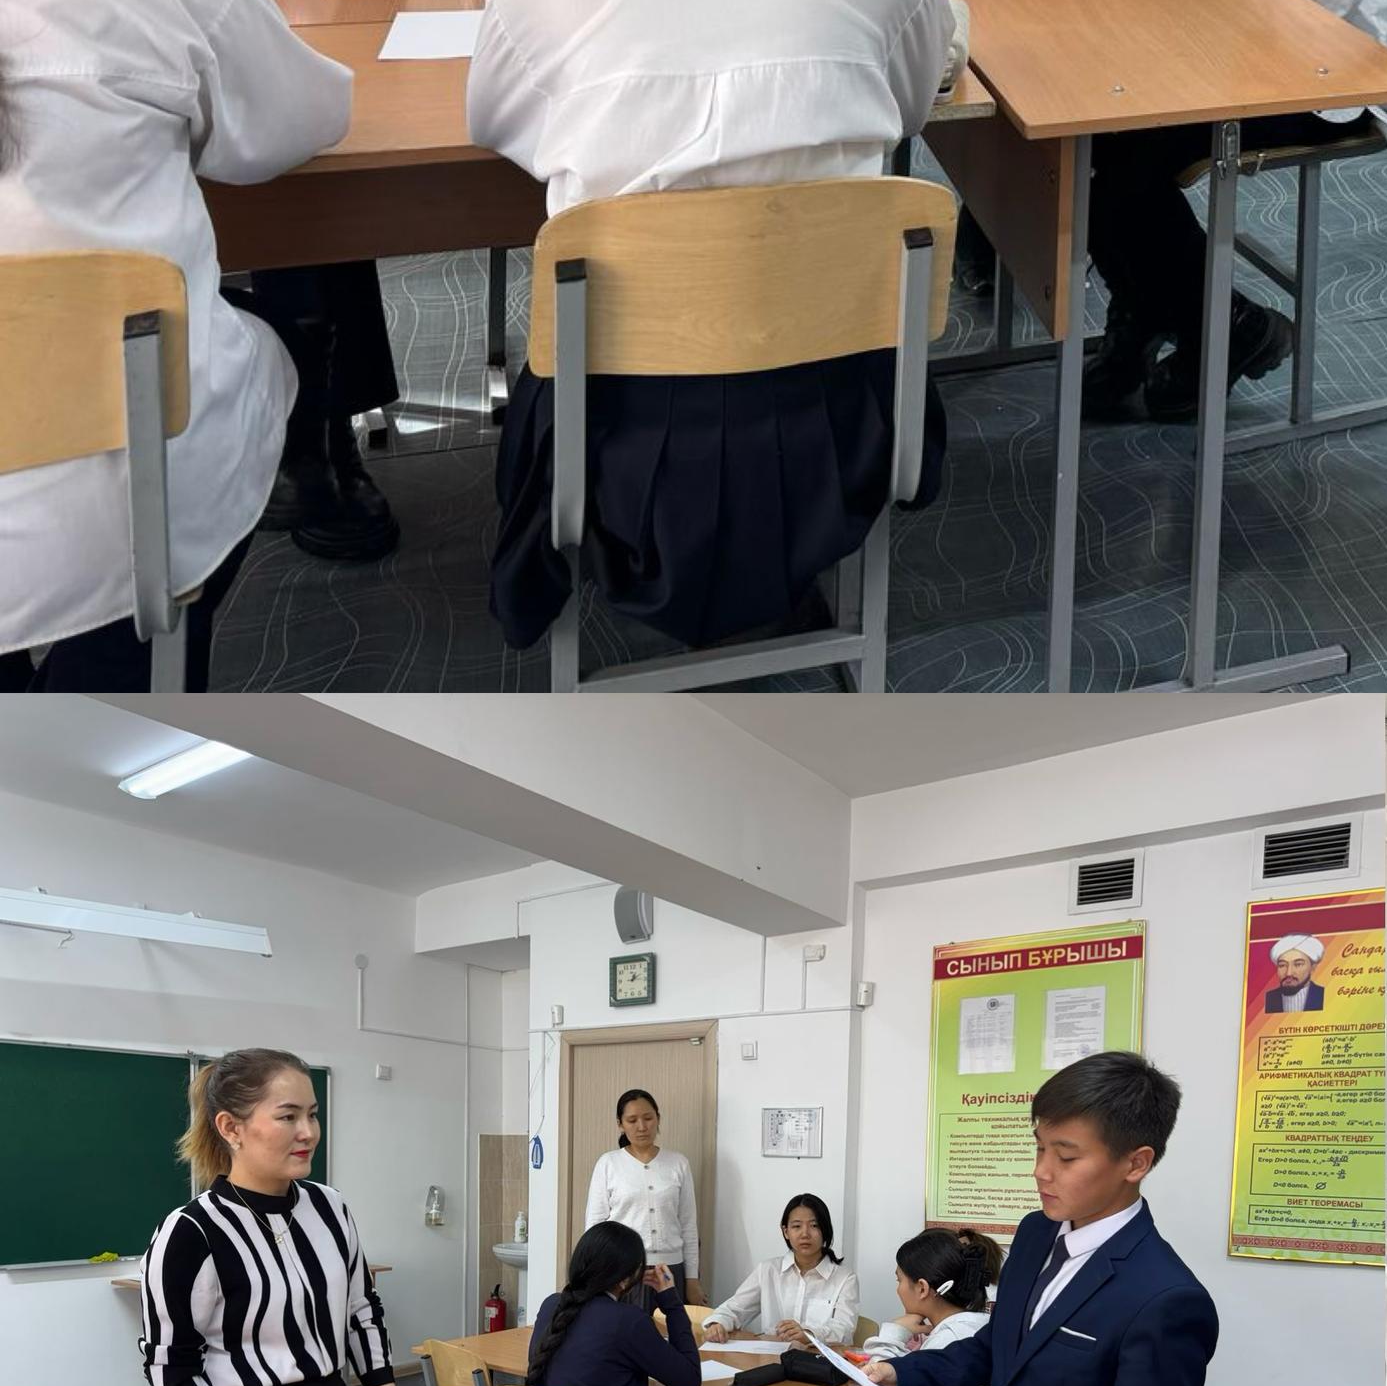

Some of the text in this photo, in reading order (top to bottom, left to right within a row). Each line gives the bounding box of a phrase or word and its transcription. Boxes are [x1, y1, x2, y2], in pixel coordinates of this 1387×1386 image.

[946, 940, 1127, 976] СЫНЫП БҰРЫШЫ
[1278, 1027, 1301, 1035] БҮТІН
[1303, 1025, 1358, 1033] КӨРСЕТКІШТІ
[1259, 1071, 1332, 1080] АРИФМЕТИКАЛЫҚ
[1307, 1079, 1358, 1087] ҚАСИЕТТЕРІ
[1286, 1135, 1374, 1143] КВАДРАТТЫҚ ТЕҢДЕУ
[1310, 1199, 1364, 1208] ТЕОРЕМАСЫ
